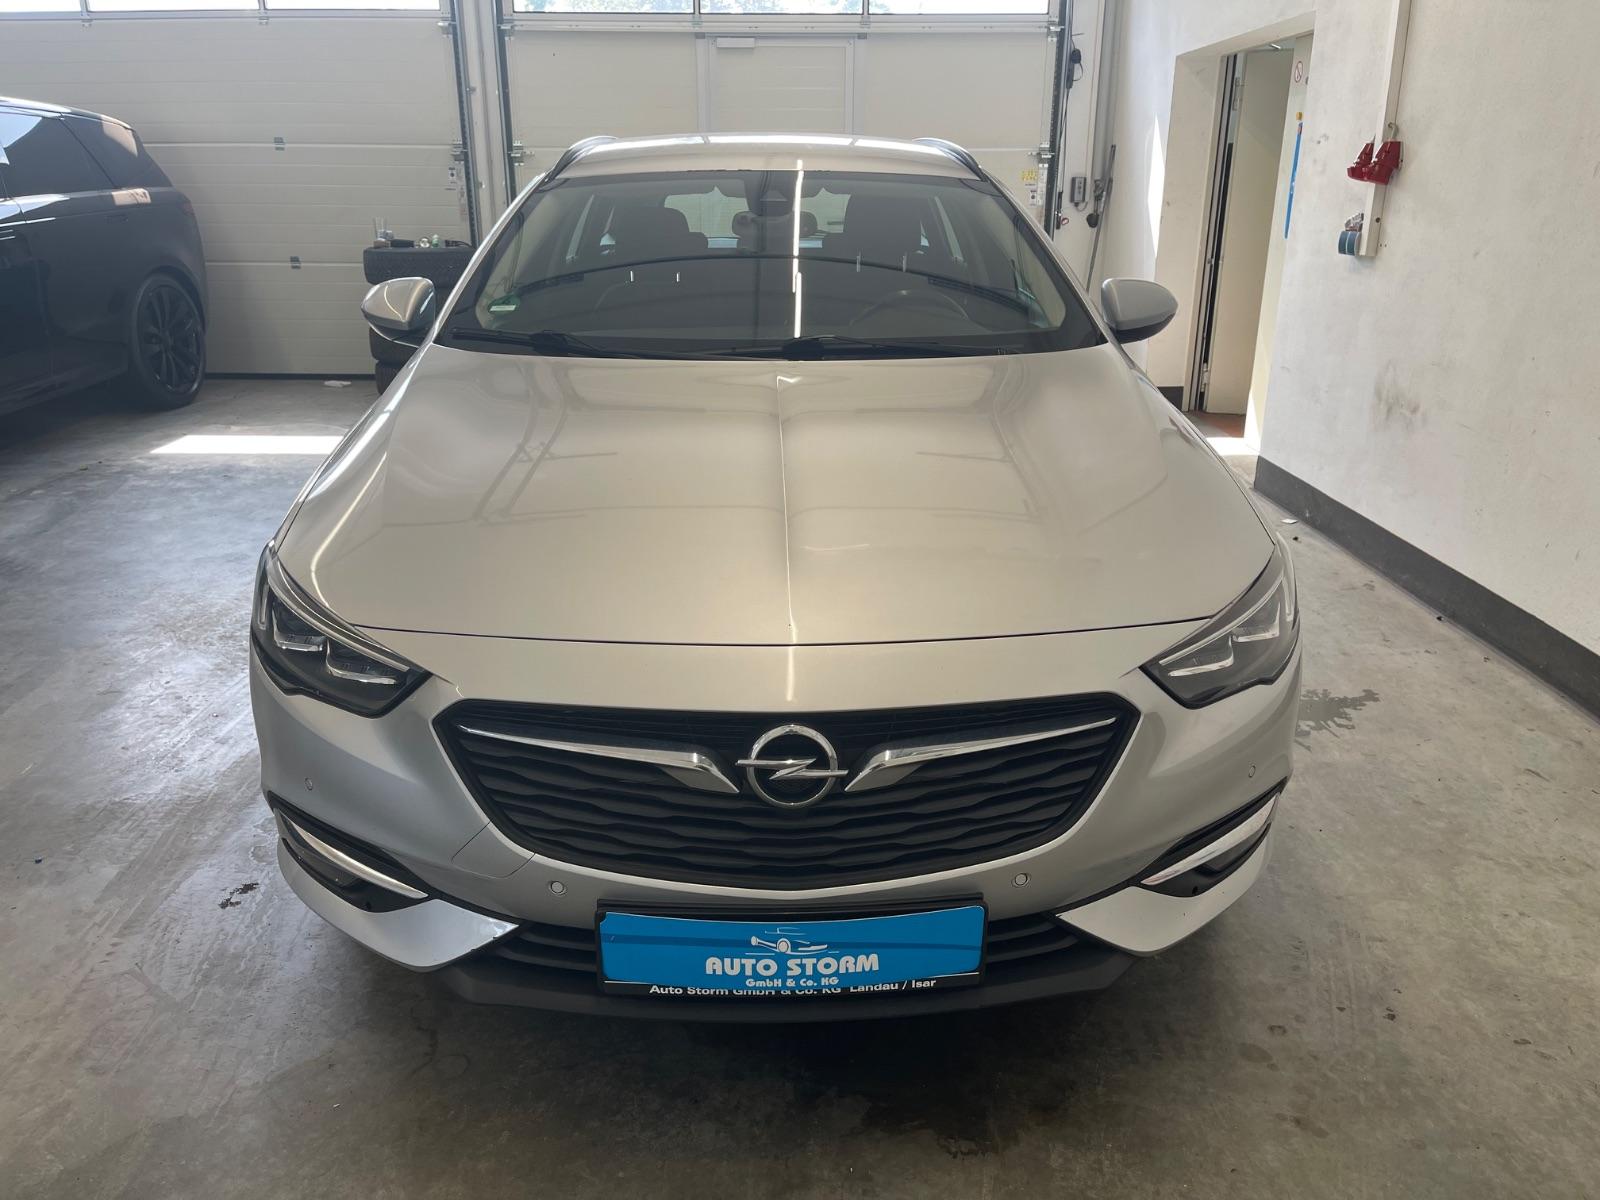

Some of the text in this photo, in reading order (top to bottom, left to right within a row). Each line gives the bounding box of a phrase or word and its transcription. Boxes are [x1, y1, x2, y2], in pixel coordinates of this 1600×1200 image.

[705, 953, 880, 977] AUTO STORM
[649, 985, 684, 995] Auto
[687, 986, 729, 996] Storm
[849, 982, 899, 993] Landau
[911, 979, 937, 989] Isar
[745, 976, 840, 988] GmbH & Co. KG
